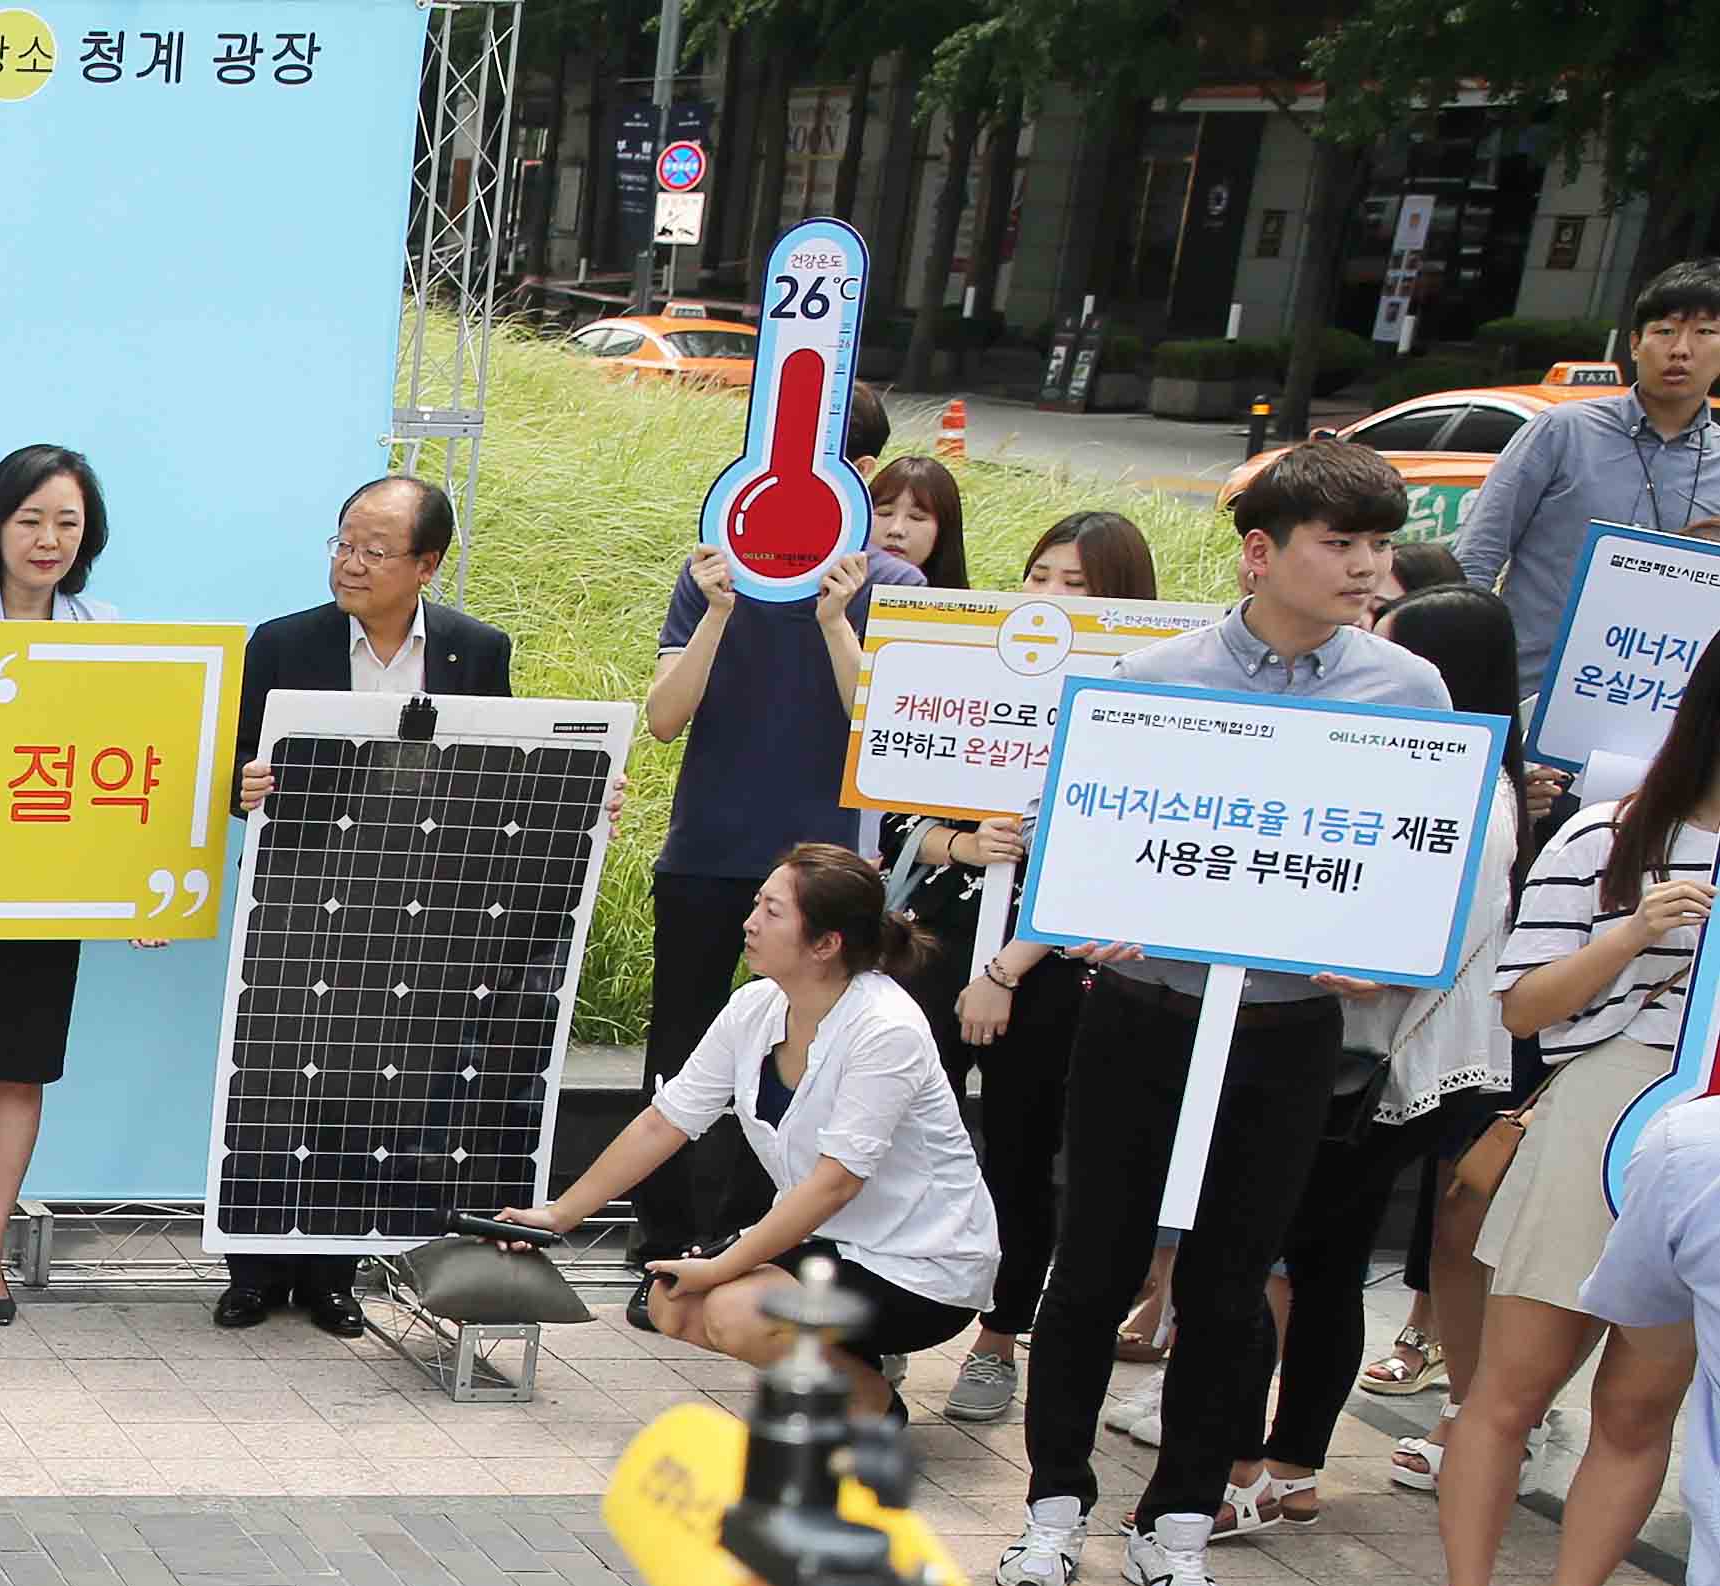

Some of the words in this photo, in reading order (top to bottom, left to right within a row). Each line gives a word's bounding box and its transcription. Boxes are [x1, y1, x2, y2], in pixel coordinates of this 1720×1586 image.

[79, 29, 185, 85] 청계
[212, 31, 322, 86] 광장
[790, 254, 843, 269] 건강온도
[1577, 371, 1614, 383] TAXI
[1605, 625, 1700, 674] 에너지
[894, 694, 1039, 728] 카쉐어링으로
[868, 729, 957, 760] 절약하고
[1328, 729, 1468, 761] 에너지시민연대
[8, 744, 162, 825] 절약
[1065, 781, 1289, 837] 에너지소비효율
[1301, 805, 1385, 847] 1등급
[1391, 815, 1461, 855] 제품
[1134, 838, 1238, 882] 사용을
[1245, 850, 1365, 894] 부탁해!
